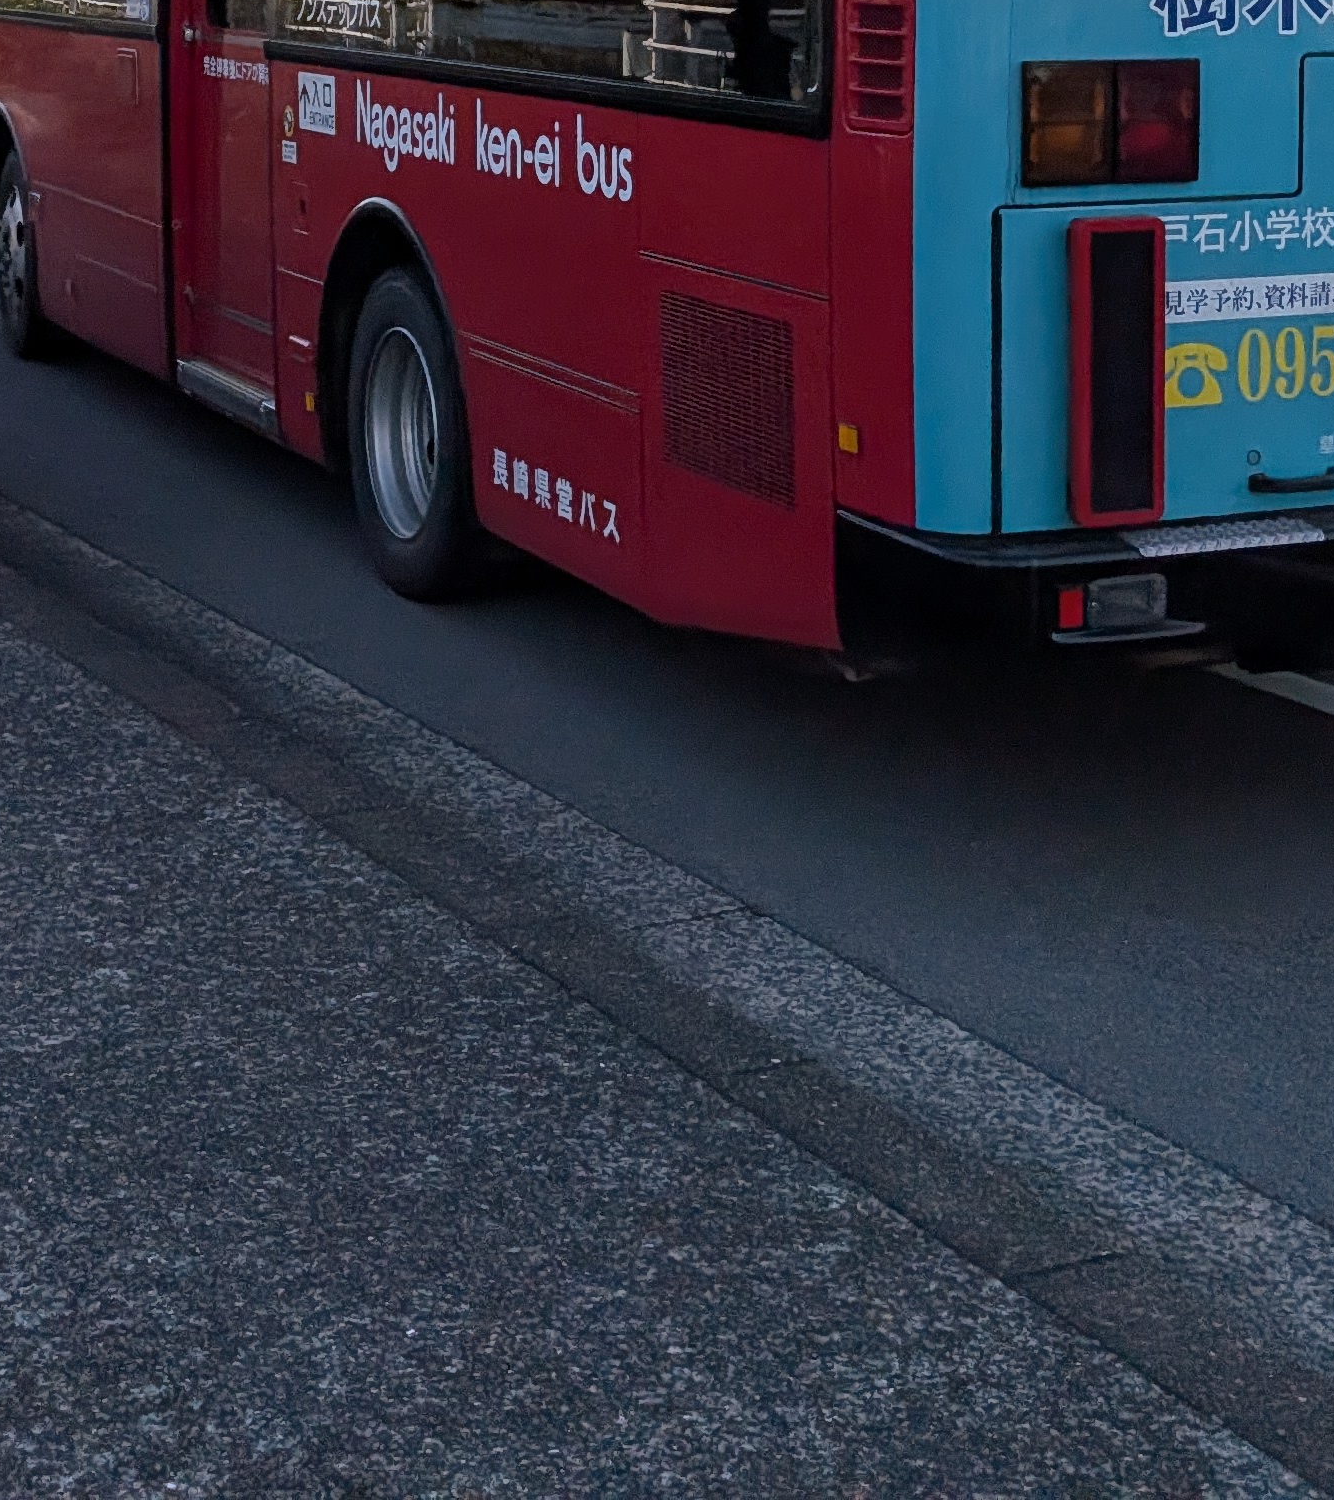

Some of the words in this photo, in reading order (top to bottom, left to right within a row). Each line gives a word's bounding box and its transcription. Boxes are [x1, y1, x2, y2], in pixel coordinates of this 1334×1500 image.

[312, 81, 332, 108] 入口
[356, 79, 455, 172] Nagasaki
[475, 98, 560, 188] ken-ei
[576, 113, 633, 202] bus
[493, 448, 621, 544] 長崎県営バス
